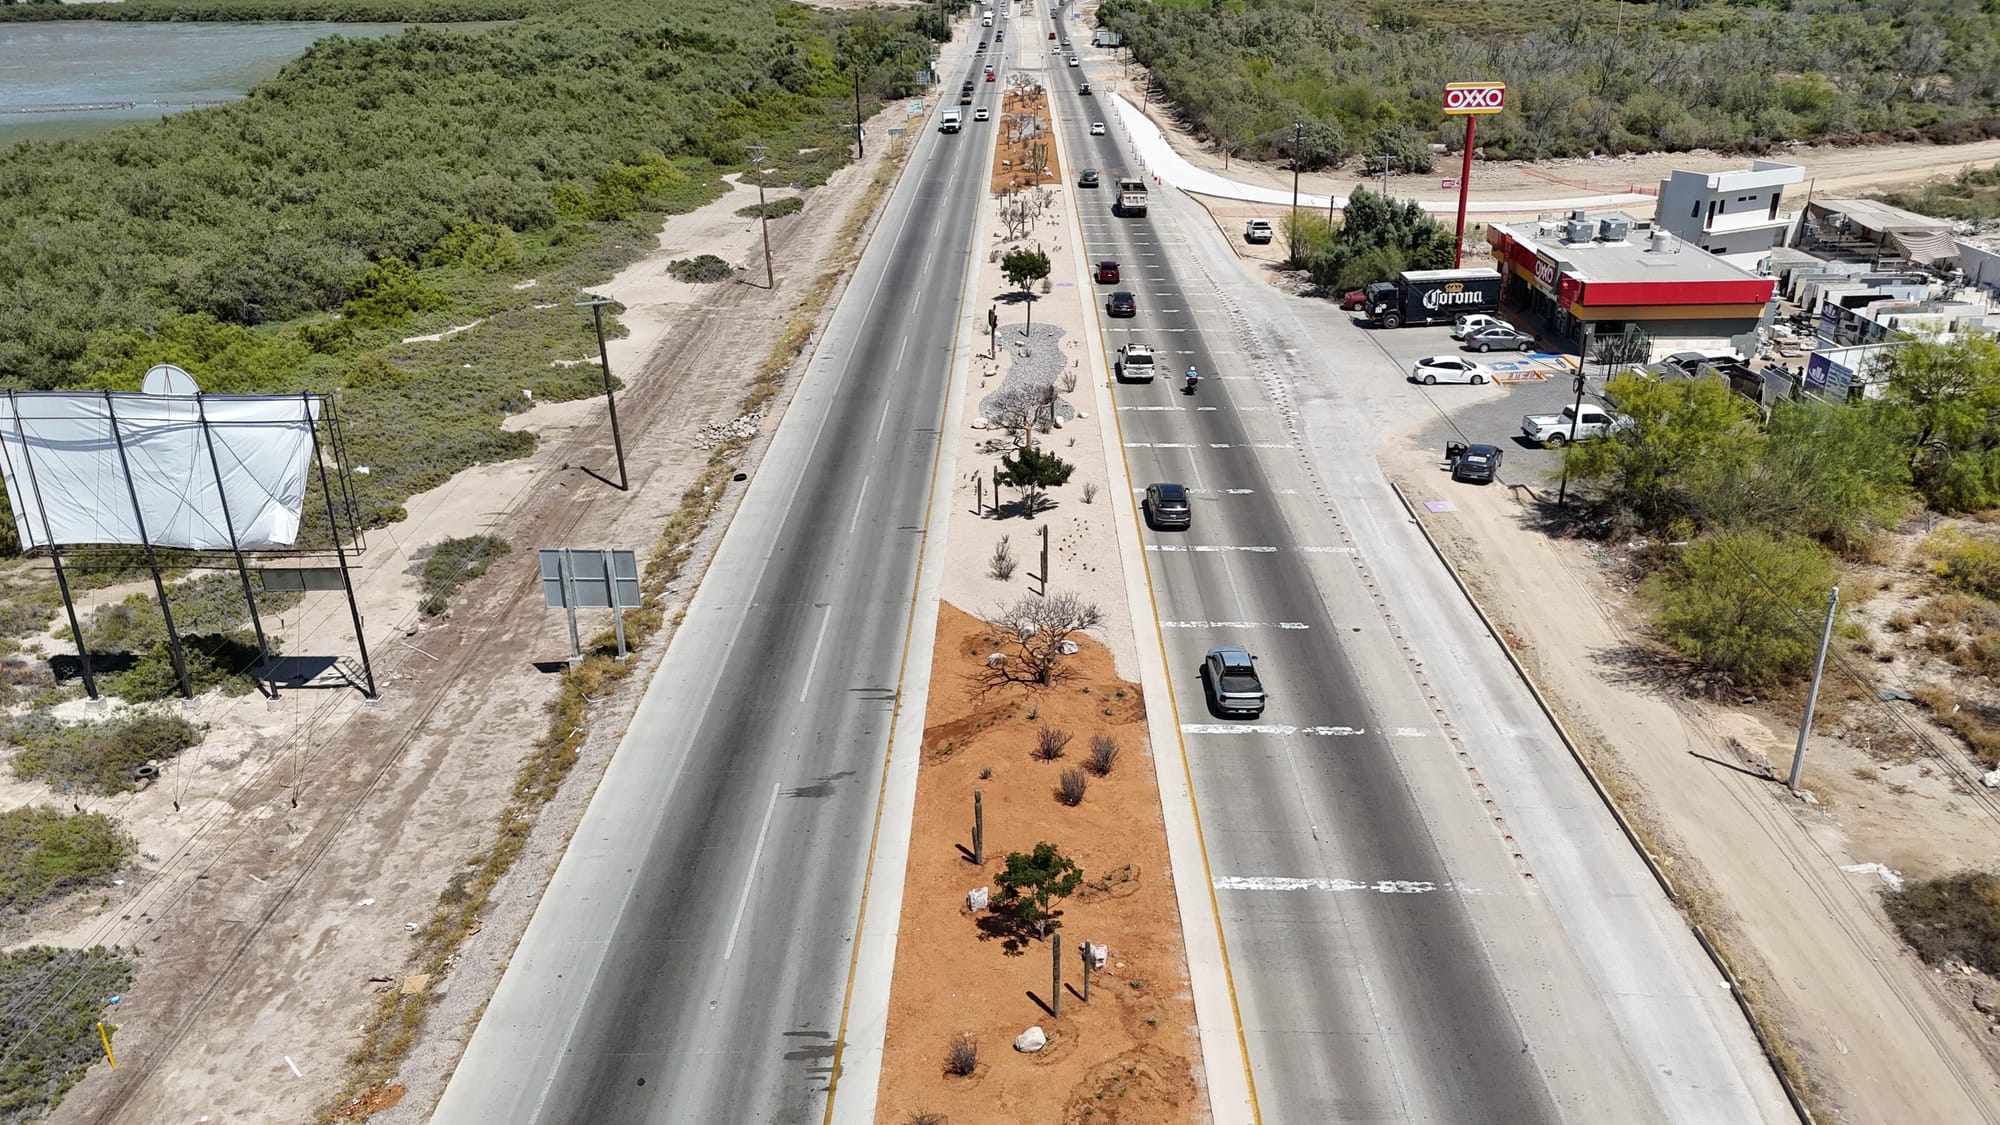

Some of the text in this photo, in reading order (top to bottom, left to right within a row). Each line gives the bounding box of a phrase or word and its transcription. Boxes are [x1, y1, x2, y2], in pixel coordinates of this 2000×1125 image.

[1447, 89, 1502, 108] OXXO
[1535, 260, 1553, 283] OXXO
[1423, 288, 1483, 311] Corona
